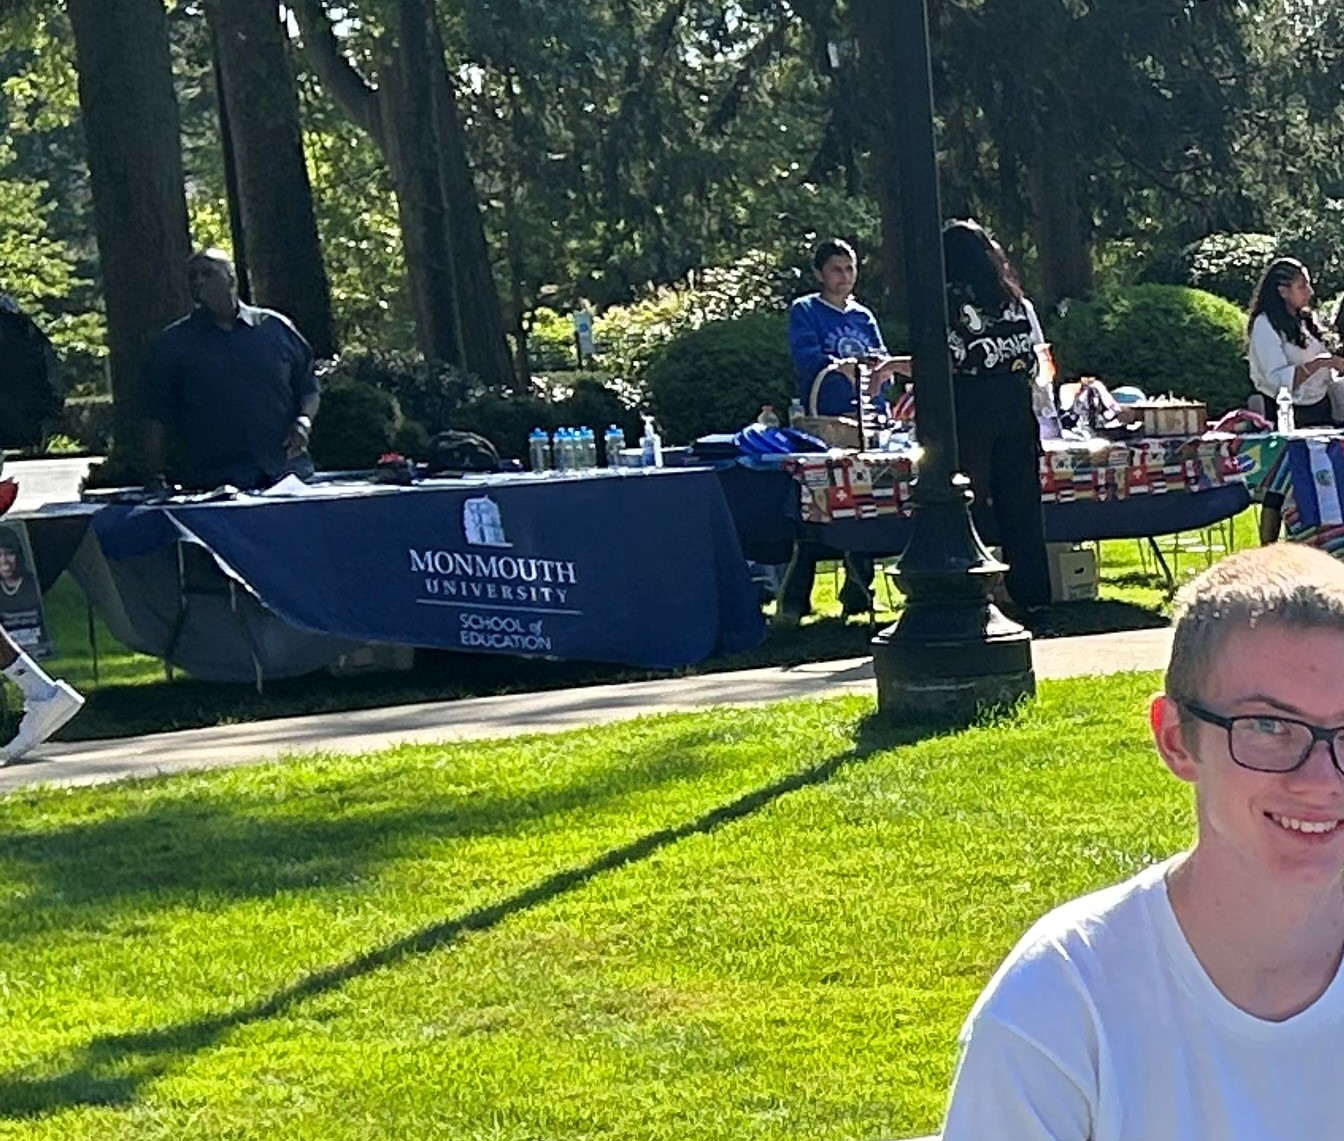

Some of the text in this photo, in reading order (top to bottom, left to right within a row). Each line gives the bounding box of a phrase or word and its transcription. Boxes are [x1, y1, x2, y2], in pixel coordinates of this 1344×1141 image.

[409, 549, 577, 584] MONMOUTH
[425, 578, 568, 603] UNIVERSITY
[459, 613, 543, 637] SCHOOL of
[460, 631, 552, 650] EDUCATION
